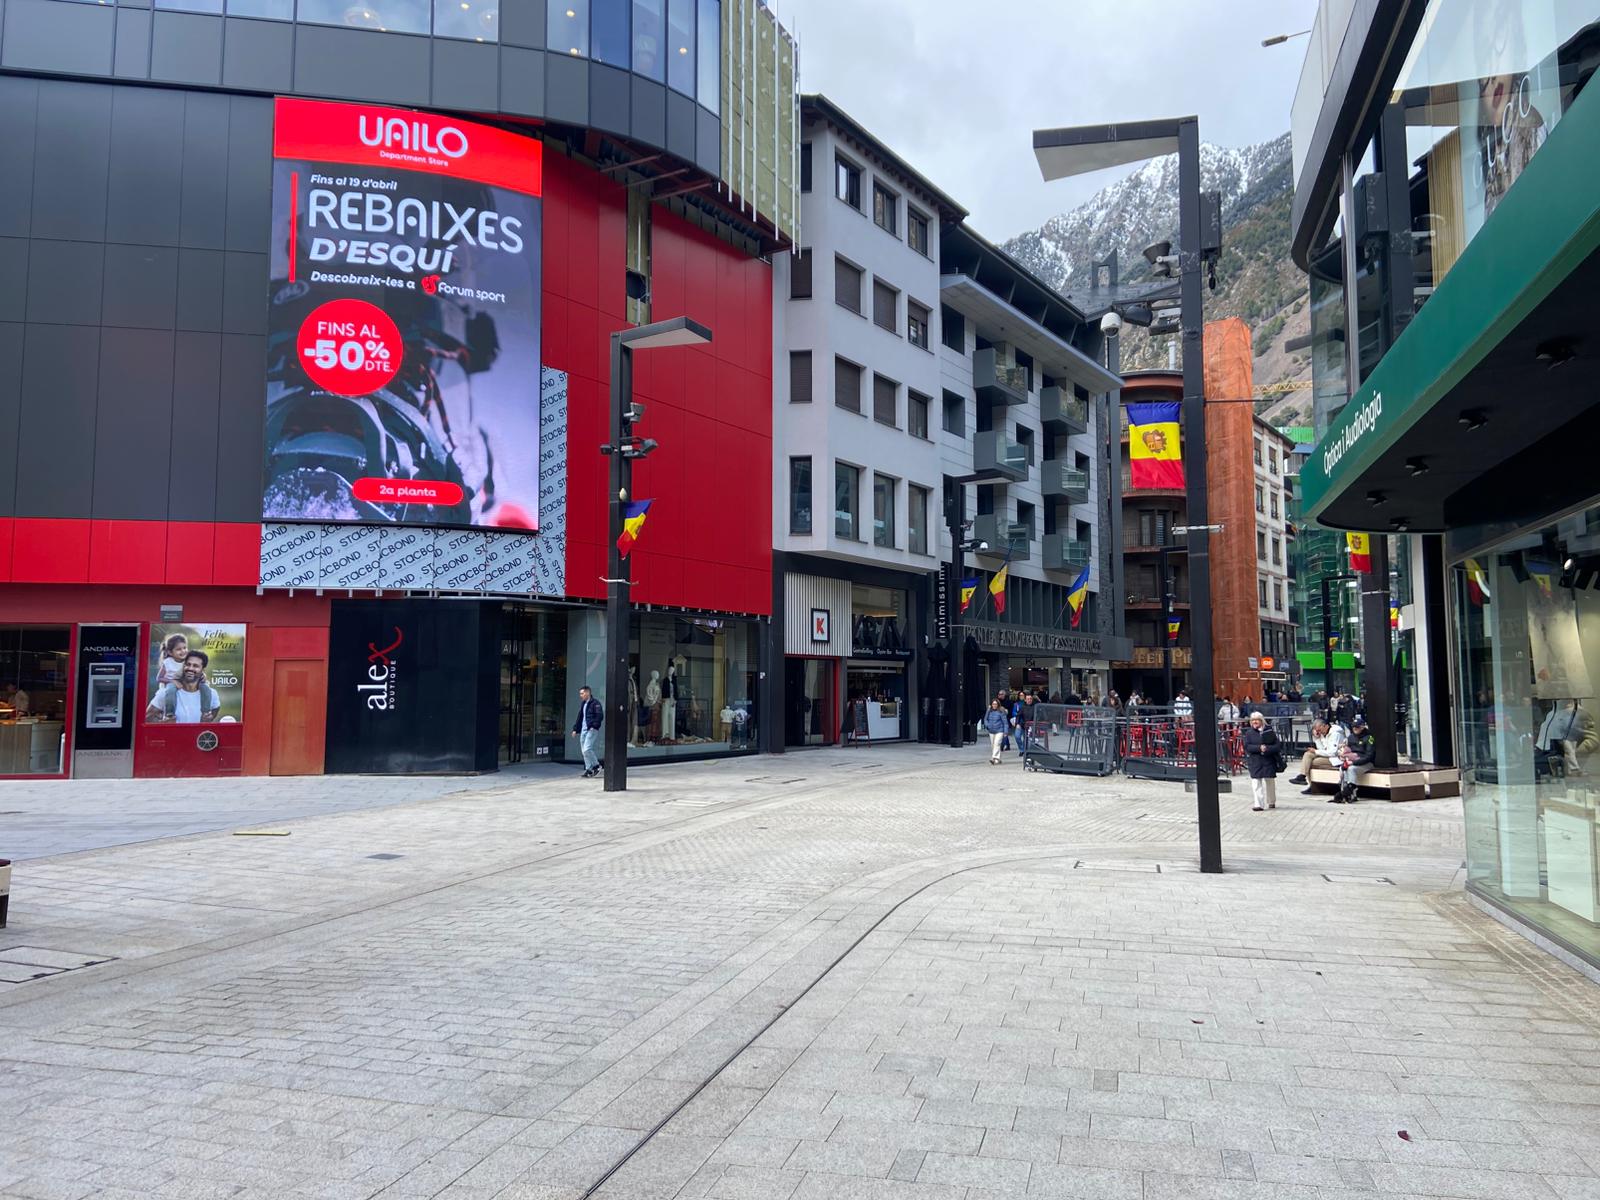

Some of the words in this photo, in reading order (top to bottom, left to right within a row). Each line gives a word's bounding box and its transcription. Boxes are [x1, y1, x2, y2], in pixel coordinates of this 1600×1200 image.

[359, 115, 469, 158] UAILO
[380, 150, 426, 163] Department
[429, 156, 449, 167] Store
[310, 175, 334, 185] Fins
[335, 177, 347, 186] al
[349, 177, 360, 187] 19
[362, 179, 398, 191] d'abril
[308, 188, 524, 254] REBAIXES
[309, 238, 458, 273] D'ESQUÍ
[310, 271, 404, 288] Descobreix-les
[406, 281, 415, 289] a
[476, 289, 506, 303] sport
[317, 321, 356, 337] FINS
[359, 324, 381, 339] AL
[379, 485, 395, 495] 2a
[397, 486, 437, 497] planta
[938, 565, 946, 638] intimissimi
[816, 617, 825, 634] K
[211, 676, 238, 685] UAILO
[357, 626, 403, 710] alex
[389, 660, 397, 710] BOUTIQUE
